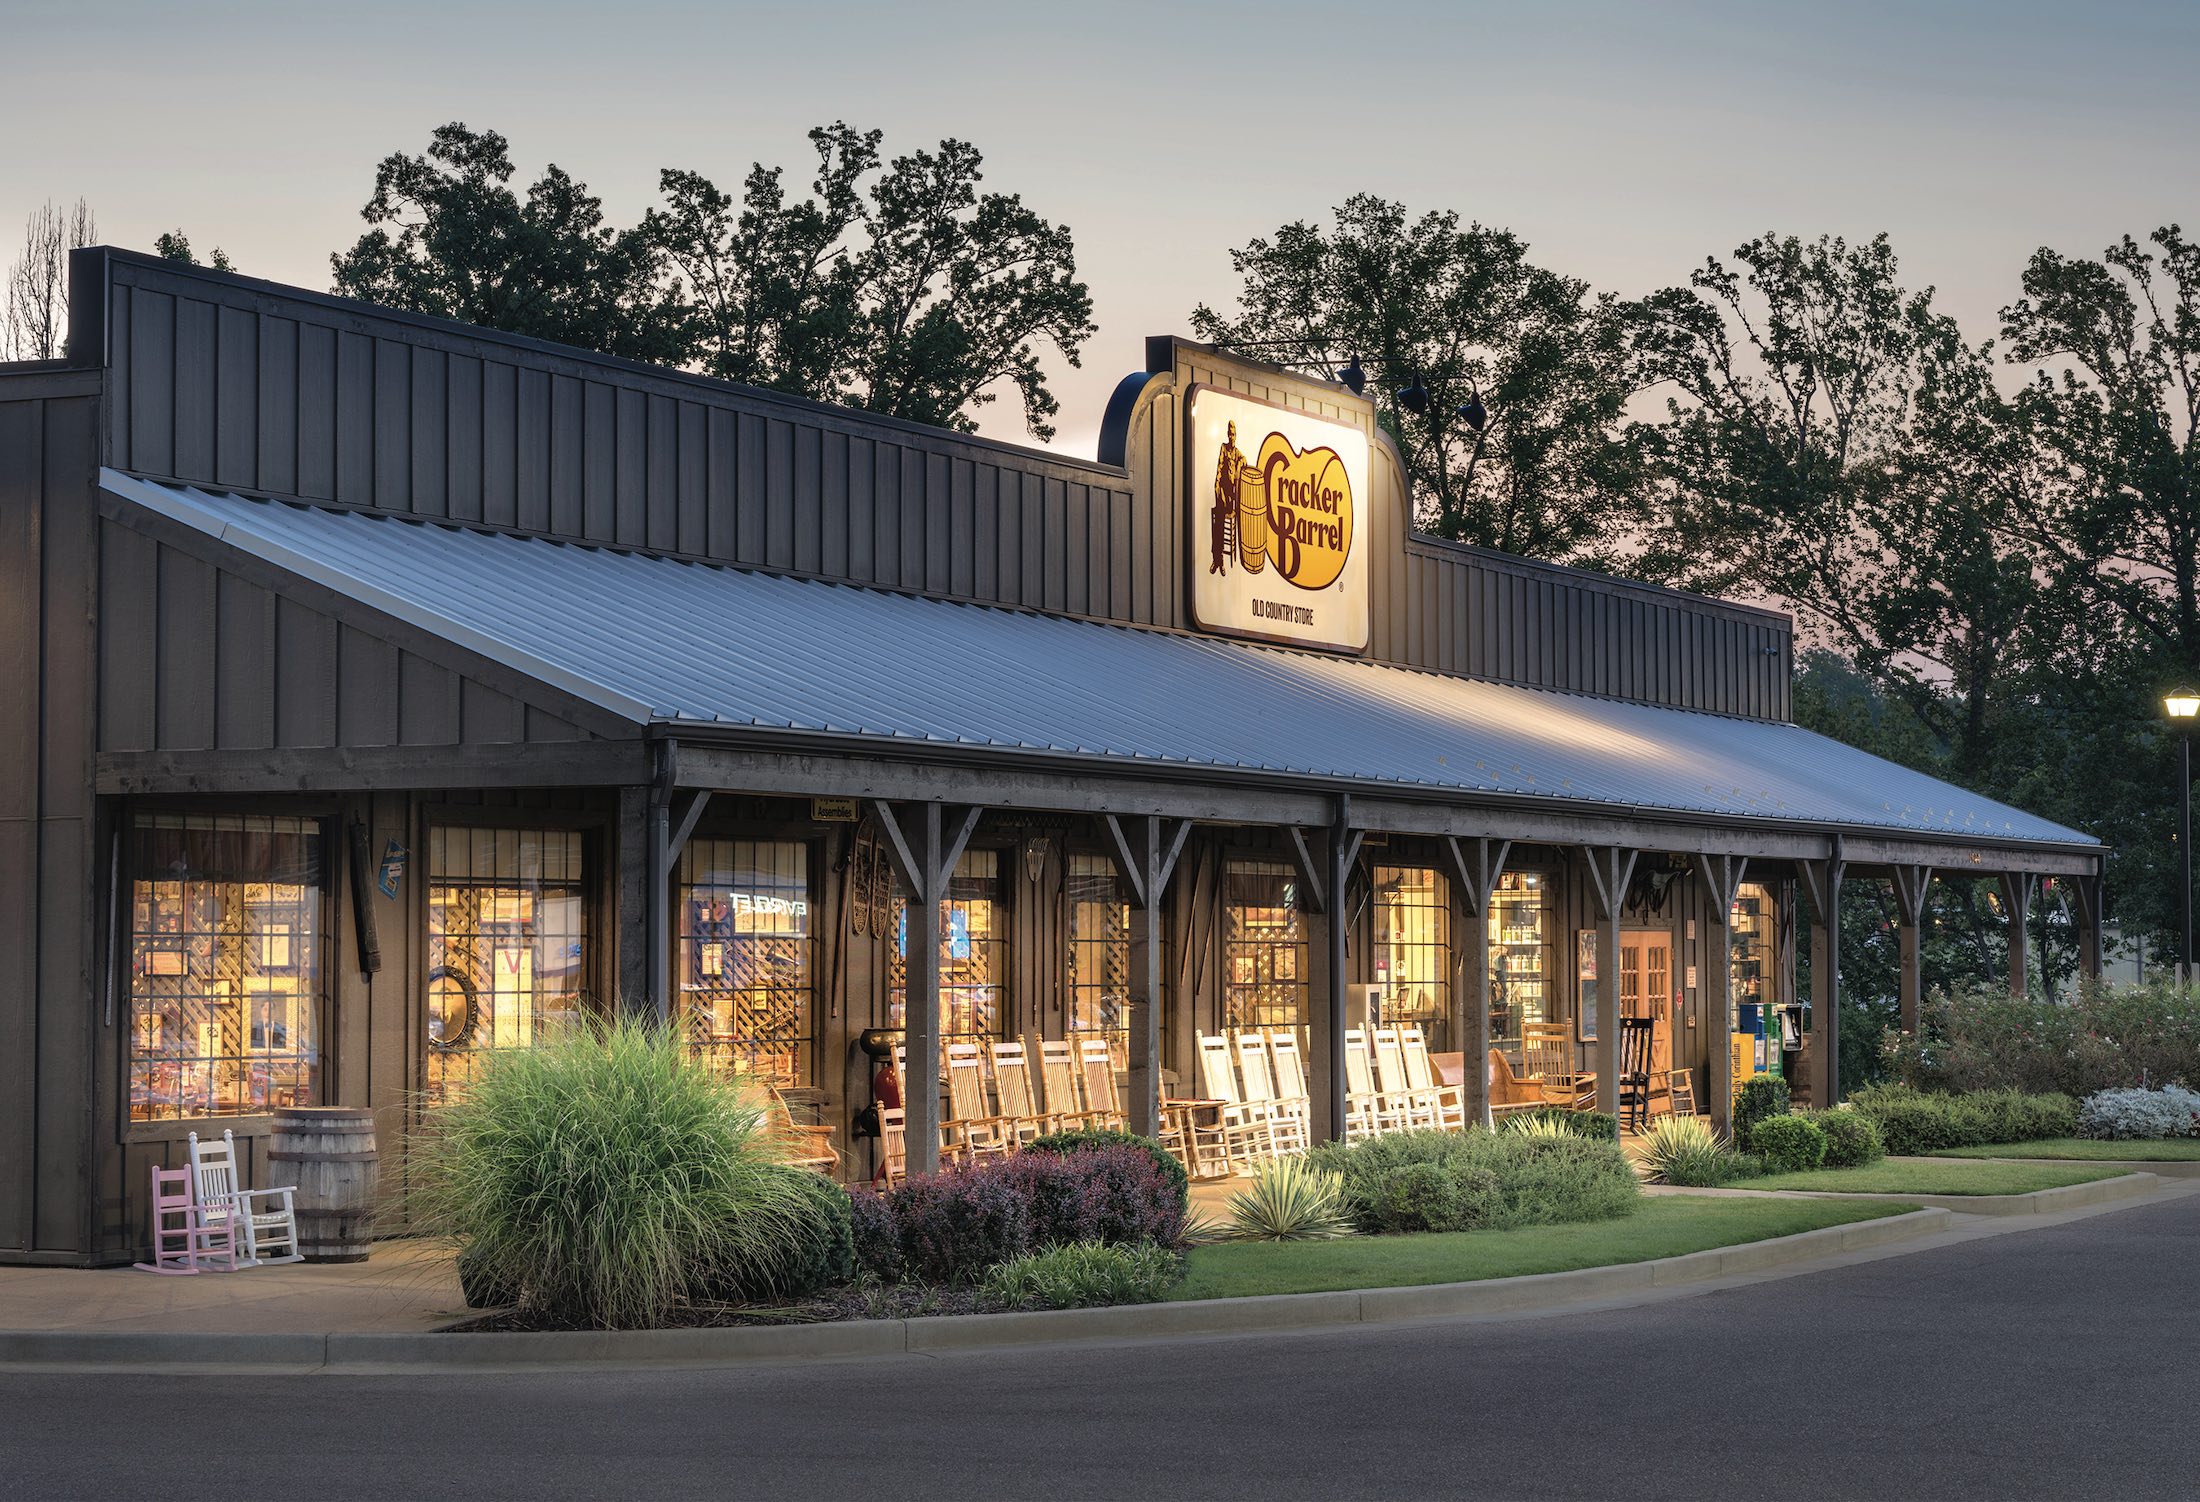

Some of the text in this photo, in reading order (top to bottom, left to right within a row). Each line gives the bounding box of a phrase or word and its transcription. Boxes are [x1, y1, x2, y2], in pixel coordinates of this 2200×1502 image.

[1263, 451, 1343, 536] Cracker
[1277, 505, 1343, 579] Barrel
[1252, 598, 1314, 626] OLD COUNTRY STORE
[818, 806, 852, 818] Assemblies
[1731, 1043, 1741, 1079] Corinthian
